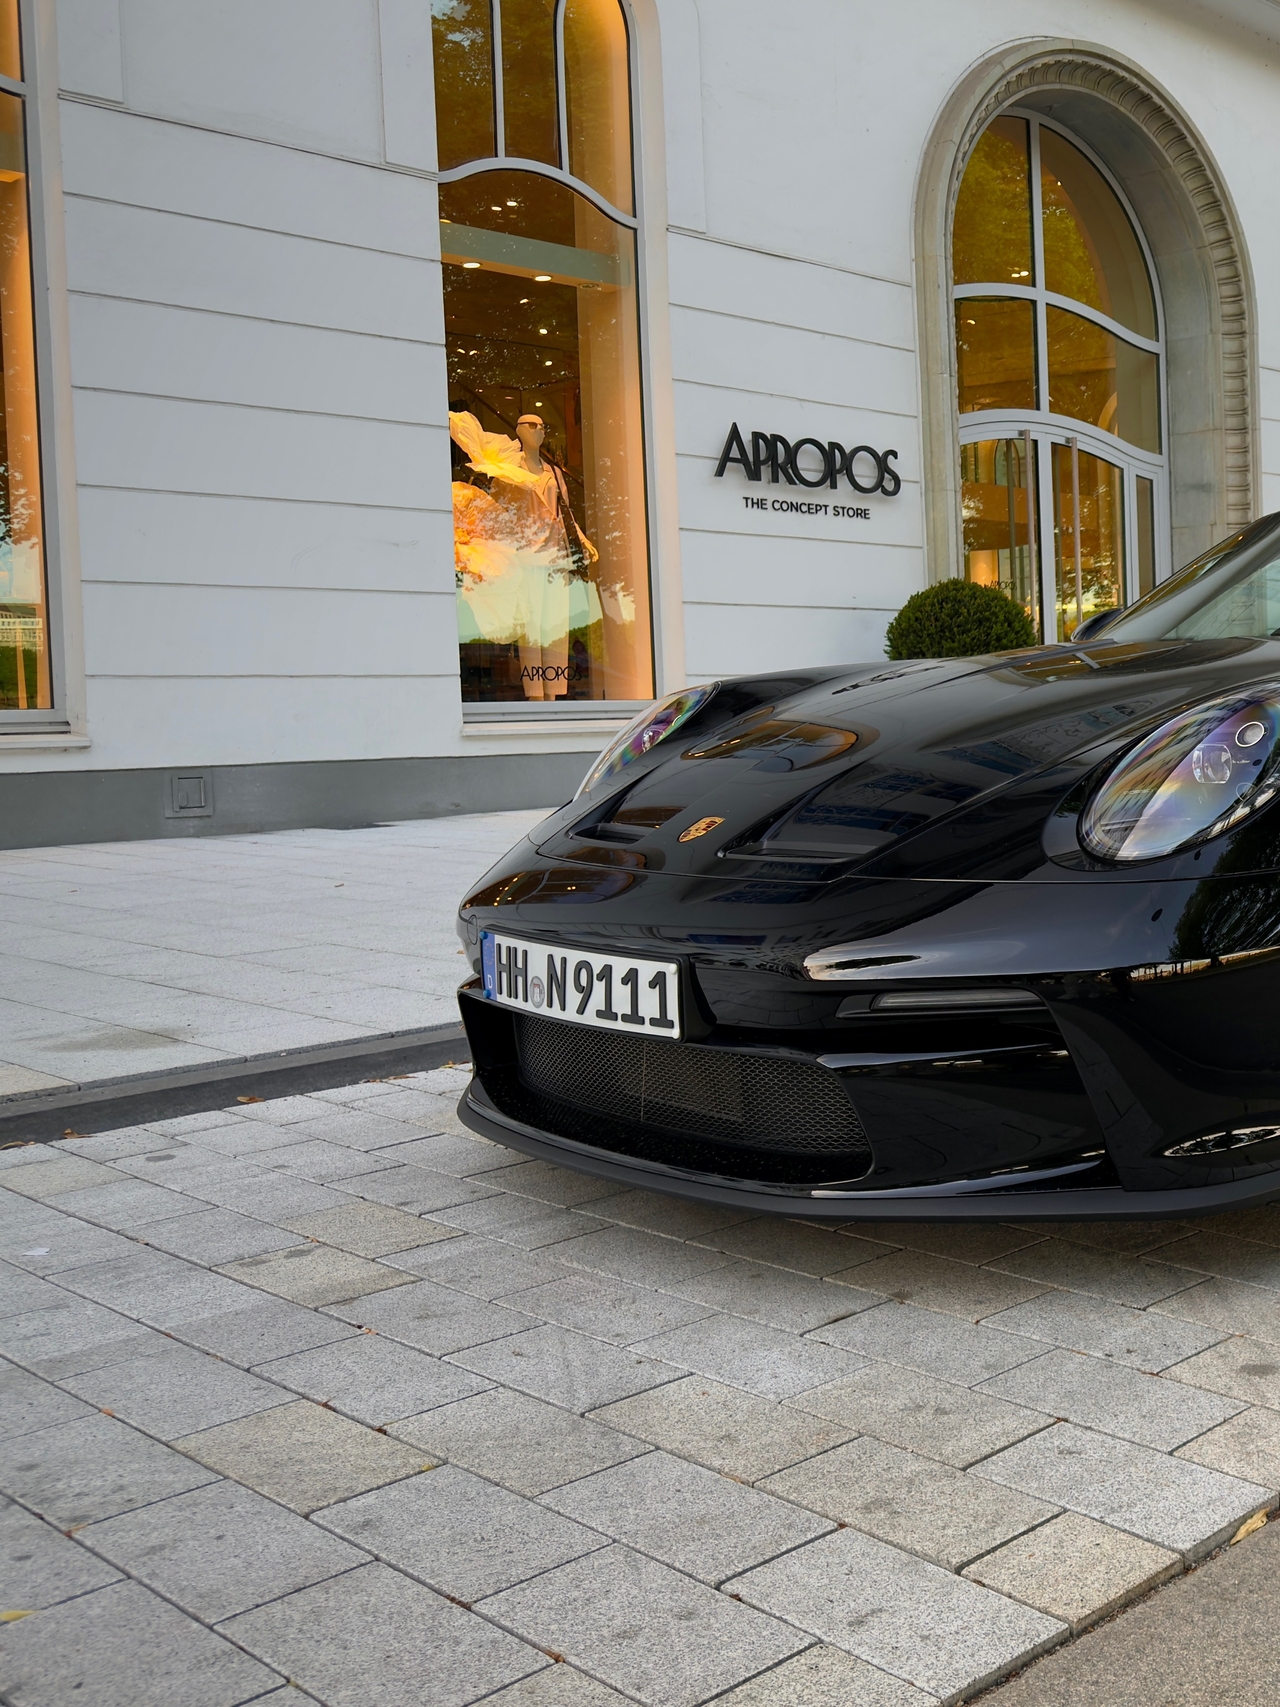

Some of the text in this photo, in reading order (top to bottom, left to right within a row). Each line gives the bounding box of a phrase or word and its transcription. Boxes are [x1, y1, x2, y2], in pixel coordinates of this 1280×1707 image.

[714, 421, 901, 497] APROPOS
[743, 496, 870, 520] THE CONCEPT STORE
[520, 665, 582, 681] APROPOS
[496, 943, 528, 1003] HH
